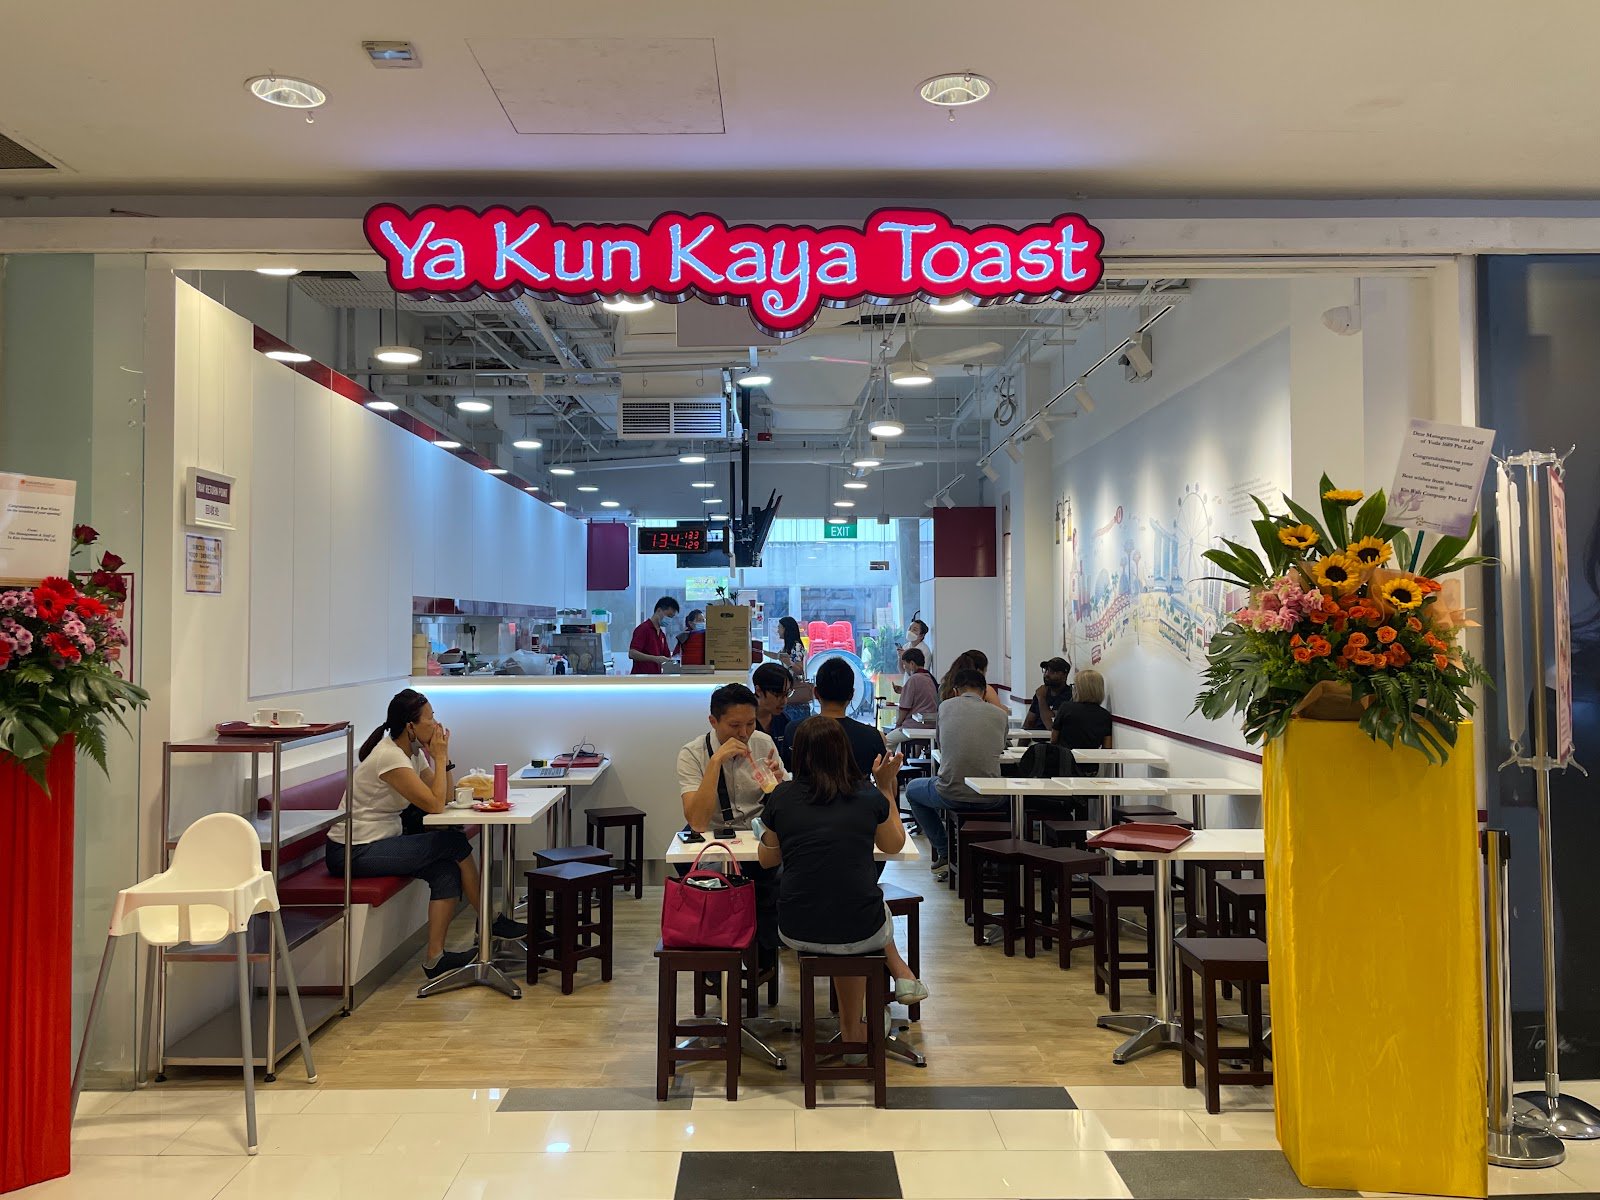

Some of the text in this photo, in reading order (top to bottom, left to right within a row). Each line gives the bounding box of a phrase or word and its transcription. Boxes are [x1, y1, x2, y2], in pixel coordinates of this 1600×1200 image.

[379, 220, 1089, 317] Ya Kun Kaya Toast
[684, 530, 700, 540] 133
[831, 526, 850, 536] EXIT
[652, 532, 680, 548] 134
[684, 540, 700, 550] 129
